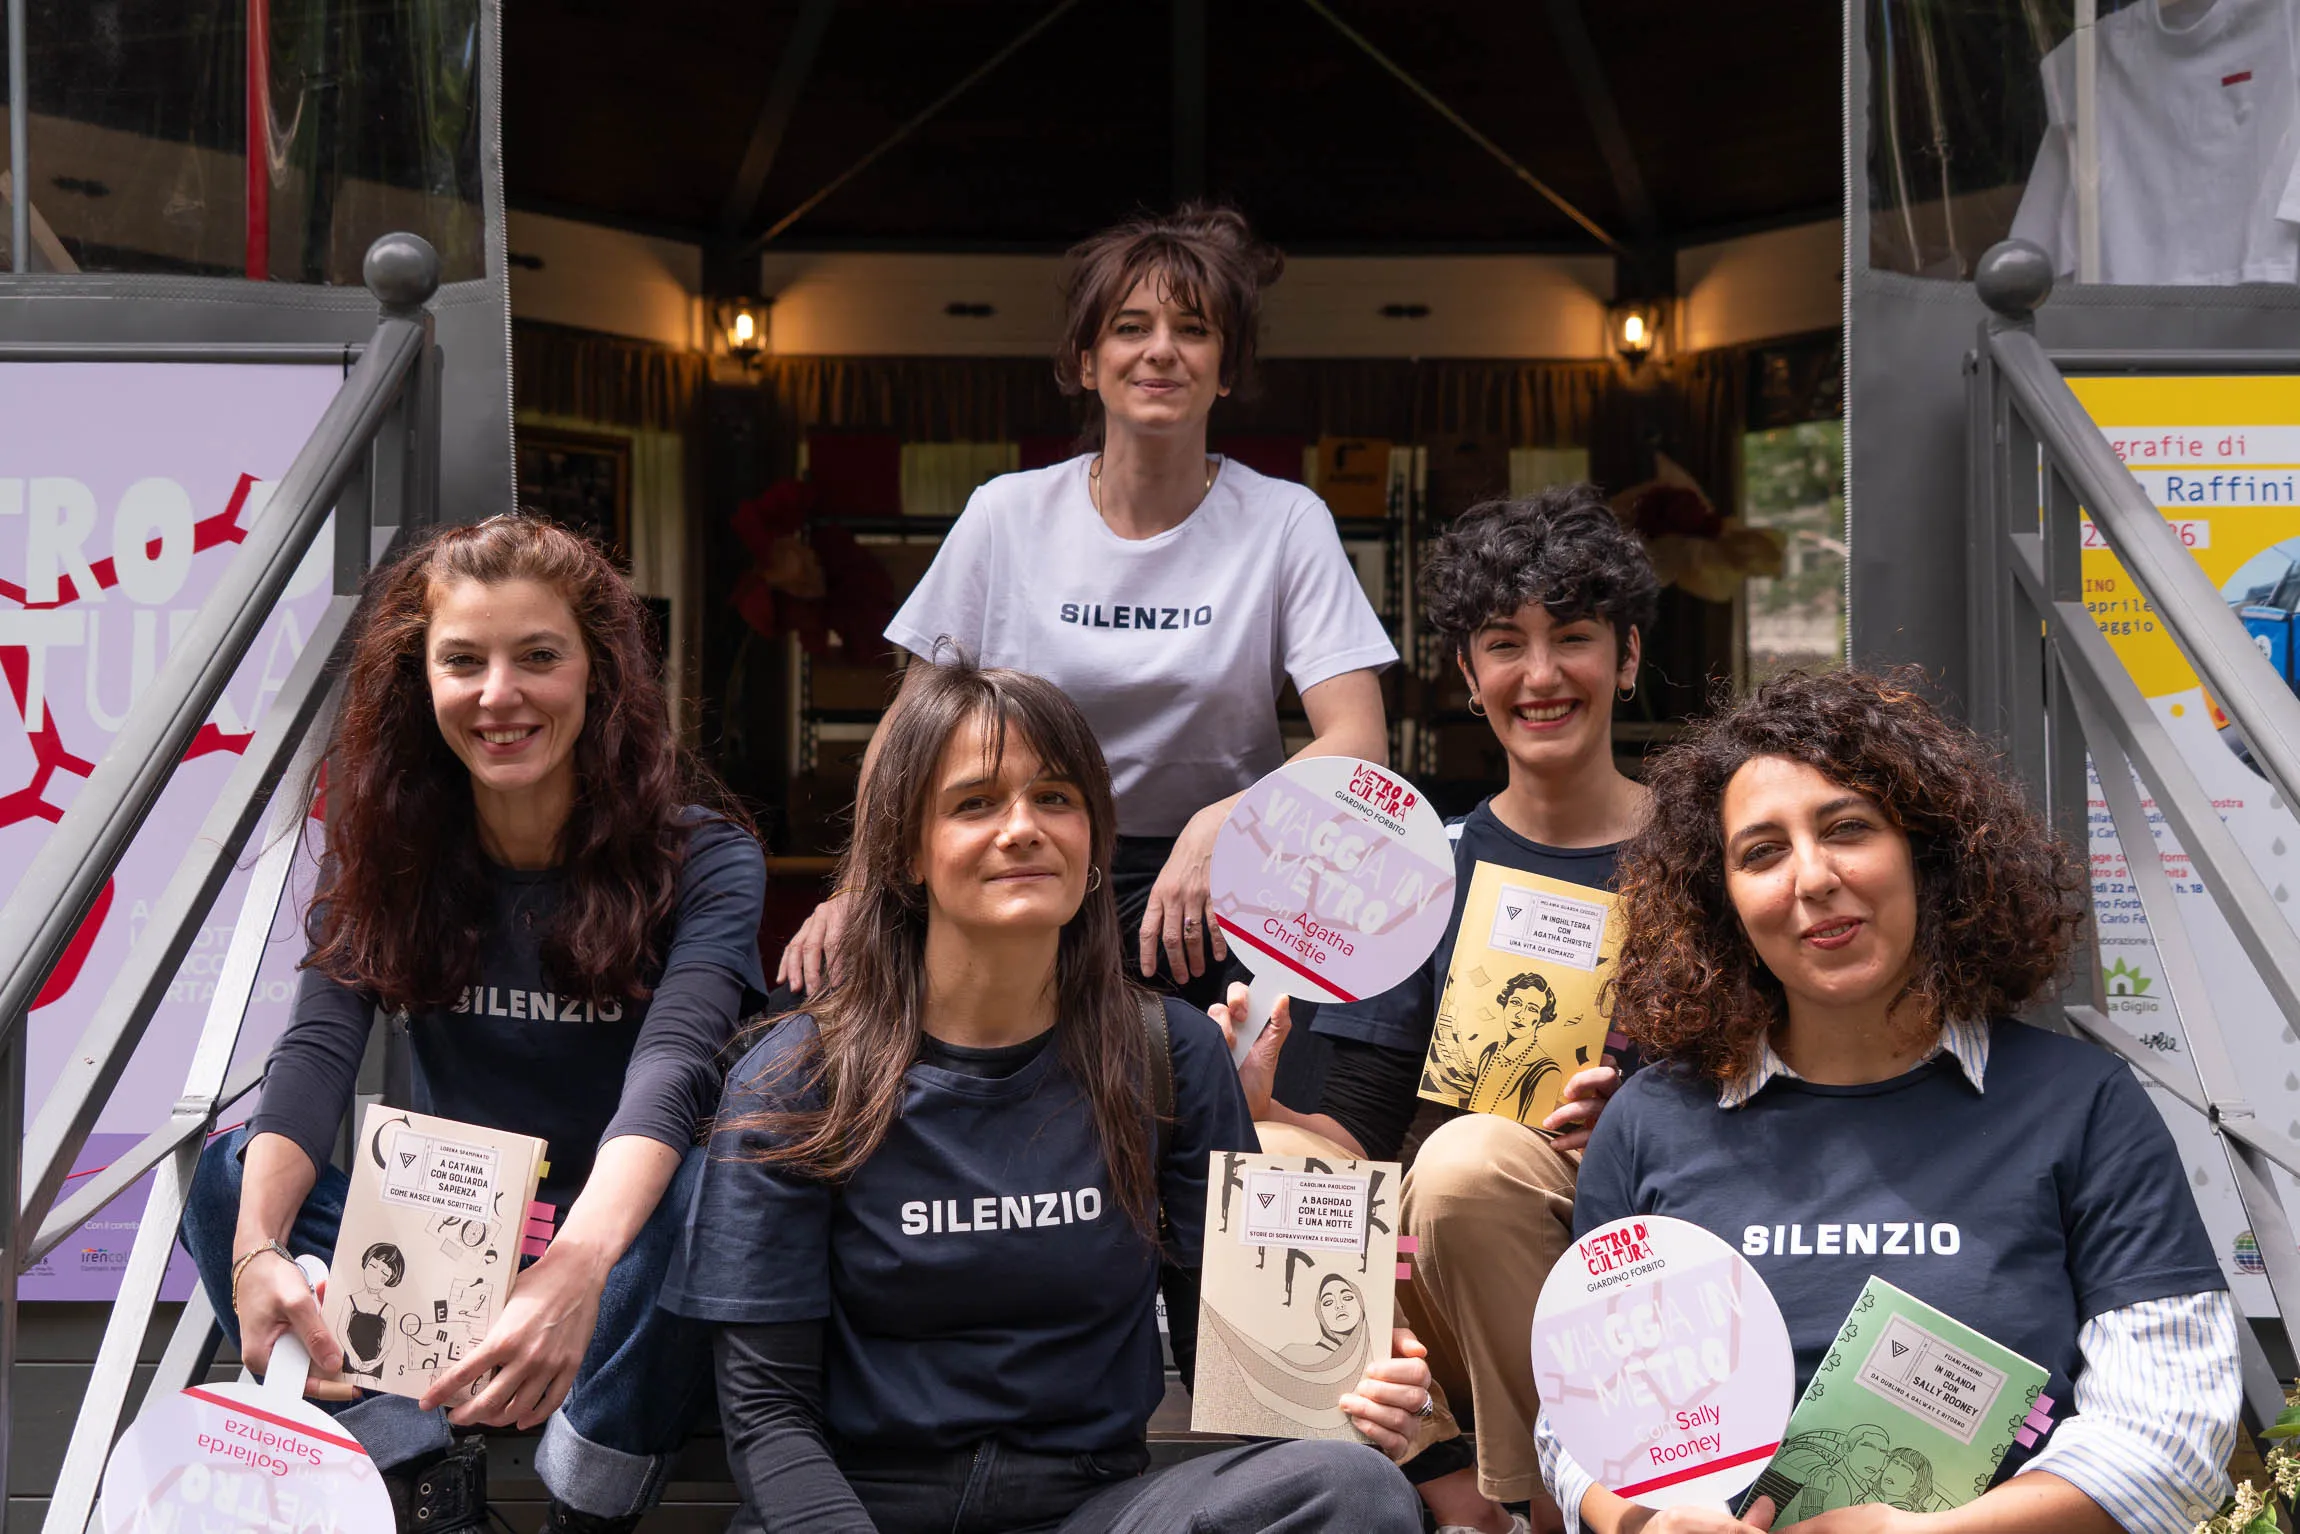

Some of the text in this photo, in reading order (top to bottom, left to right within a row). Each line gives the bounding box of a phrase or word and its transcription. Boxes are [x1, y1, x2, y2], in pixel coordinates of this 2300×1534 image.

[2112, 435, 2245, 461] grafie di
[2167, 476, 2294, 501] Raffini
[2085, 579, 2115, 592] INO
[1060, 603, 1212, 630] SILENZIO
[2100, 619, 2153, 635] aggio
[1353, 763, 1419, 811] METRO DI
[1335, 790, 1406, 836] GIARDINO FORBITO
[1349, 779, 1406, 823] CULTURA
[2210, 799, 2244, 809] ostra
[1293, 912, 1354, 957] Agatha
[1549, 916, 1591, 931] INGHILTERRA
[1557, 926, 1571, 935] CON
[1263, 917, 1326, 965] Christie
[1509, 939, 1521, 947] UNA
[1523, 942, 1536, 950] VITA
[1547, 948, 1574, 959] ROMANZO
[1533, 930, 1592, 949] AGATHA CHRISTIE
[2121, 1001, 2159, 1014] Giglio
[431, 1169, 488, 1188] CON GOLIARDA
[440, 1160, 484, 1176] A CATANIA
[438, 1182, 477, 1198] SAPIENZA
[1299, 1181, 1327, 1189] CAROLINA
[390, 1188, 408, 1198] COME
[409, 1191, 431, 1202] NASCE
[432, 1197, 446, 1206] UNA
[447, 1200, 483, 1213] SCRITTRICE
[901, 1187, 1101, 1236] SILENZIO
[1298, 1206, 1354, 1218] CON LE MILLE
[1301, 1196, 1352, 1207] A BAGHDAD
[1298, 1217, 1353, 1229] E UNA NOTTE
[1276, 1233, 1319, 1241] SOPRAVVIVENZA
[1324, 1237, 1358, 1245] RIVOLUZIONE
[1579, 1220, 1649, 1260] METRO DI
[1742, 1222, 1961, 1256] SILENZIO
[1588, 1241, 1654, 1275] CULTURA
[1587, 1259, 1665, 1292] GIARDINO FORBITO
[1934, 1364, 1976, 1392] IN IRLANDA
[1944, 1353, 1983, 1378] FUANI MARINO
[1913, 1376, 1979, 1417] SALLY ROONEY
[1942, 1381, 1959, 1394] CON
[1870, 1373, 1880, 1381] DA
[1880, 1378, 1905, 1395] DUBLINO
[1911, 1395, 1935, 1412] GALWAY
[1941, 1412, 1965, 1428] RITORNO
[1676, 1404, 1720, 1430] Sally
[198, 1432, 289, 1477] Goliarda
[225, 1419, 323, 1466] Sapienza
[1650, 1432, 1720, 1466] Rooney
